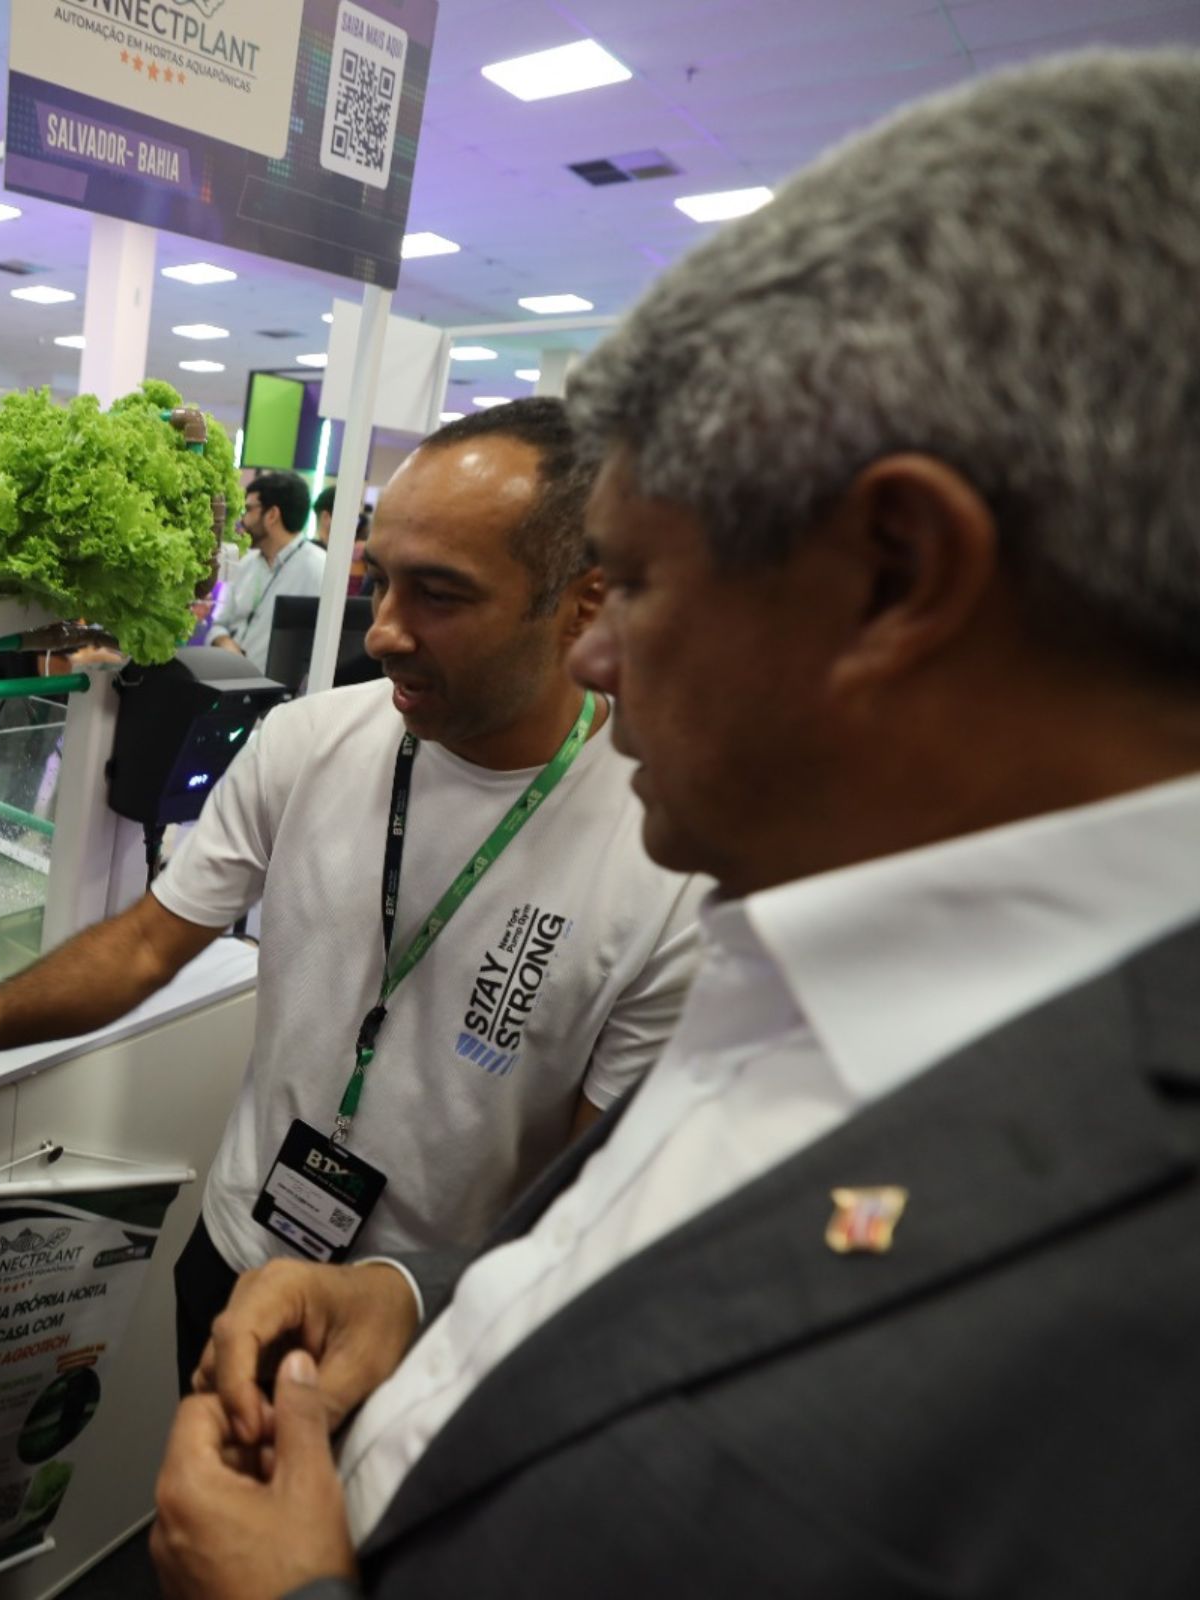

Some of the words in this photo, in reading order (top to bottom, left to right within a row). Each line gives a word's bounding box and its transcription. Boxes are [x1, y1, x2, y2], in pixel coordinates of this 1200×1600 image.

[54, 7, 125, 43] AUTOMAÇÃO
[127, 35, 143, 49] EM
[144, 43, 185, 68] HORTAS
[186, 59, 251, 93] AQUAPÔNICAS
[78, 0, 260, 71] NECTPLANT
[138, 141, 179, 183] BAHIA
[506, 907, 520, 928] York
[464, 950, 509, 1036] STAY
[495, 912, 566, 1051] STRONG
[67, 1283, 107, 1303] HORTA
[32, 1313, 65, 1335] COM
